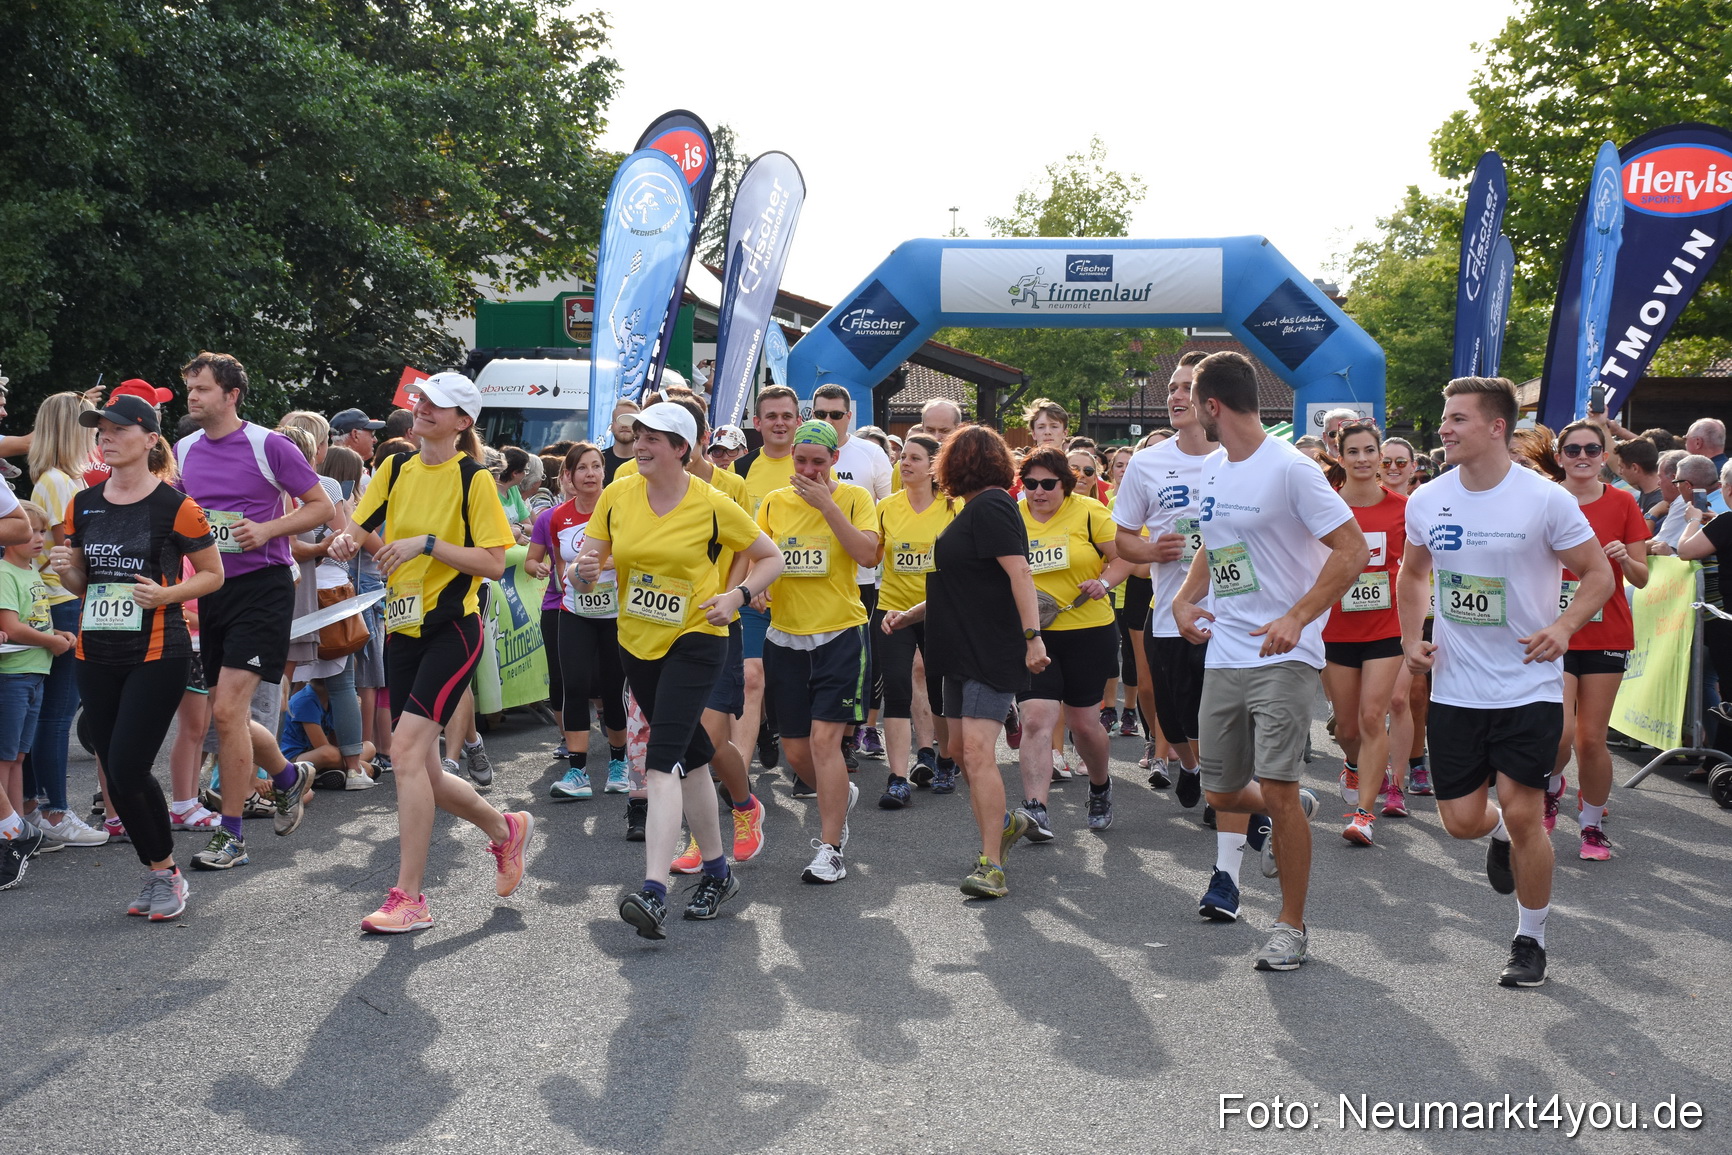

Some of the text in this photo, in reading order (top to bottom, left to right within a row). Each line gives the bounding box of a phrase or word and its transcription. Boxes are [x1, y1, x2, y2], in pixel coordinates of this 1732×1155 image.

[1627, 162, 1732, 200] Hervis
[1640, 195, 1683, 204] SPORTS
[747, 177, 783, 276] Fischer
[763, 191, 790, 270] AUTOMOBILE
[1471, 178, 1496, 282] Fischer
[1479, 192, 1499, 276] AUTOMOBILE
[1075, 264, 1111, 272] Fischer
[1048, 282, 1153, 301] firmenlauf
[850, 318, 906, 329] Fischer
[1262, 317, 1278, 327] und
[1279, 316, 1295, 324] das
[480, 384, 525, 394] abavent
[1216, 502, 1261, 513] Breitbandberatung
[1466, 531, 1526, 539] Breitbandberatung
[84, 543, 124, 556] HECK
[783, 550, 823, 565] 2013
[1028, 547, 1063, 565] 2016
[89, 556, 145, 570] DESIGN
[1213, 563, 1241, 584] 346
[578, 593, 611, 606] 1903
[631, 587, 681, 613] 2006
[1351, 586, 1380, 600] 466
[1451, 590, 1489, 612] 340
[90, 600, 134, 617] 1019
[387, 596, 415, 620] 2007
[1559, 595, 1574, 609] 5
[506, 656, 533, 680] neumarkt
